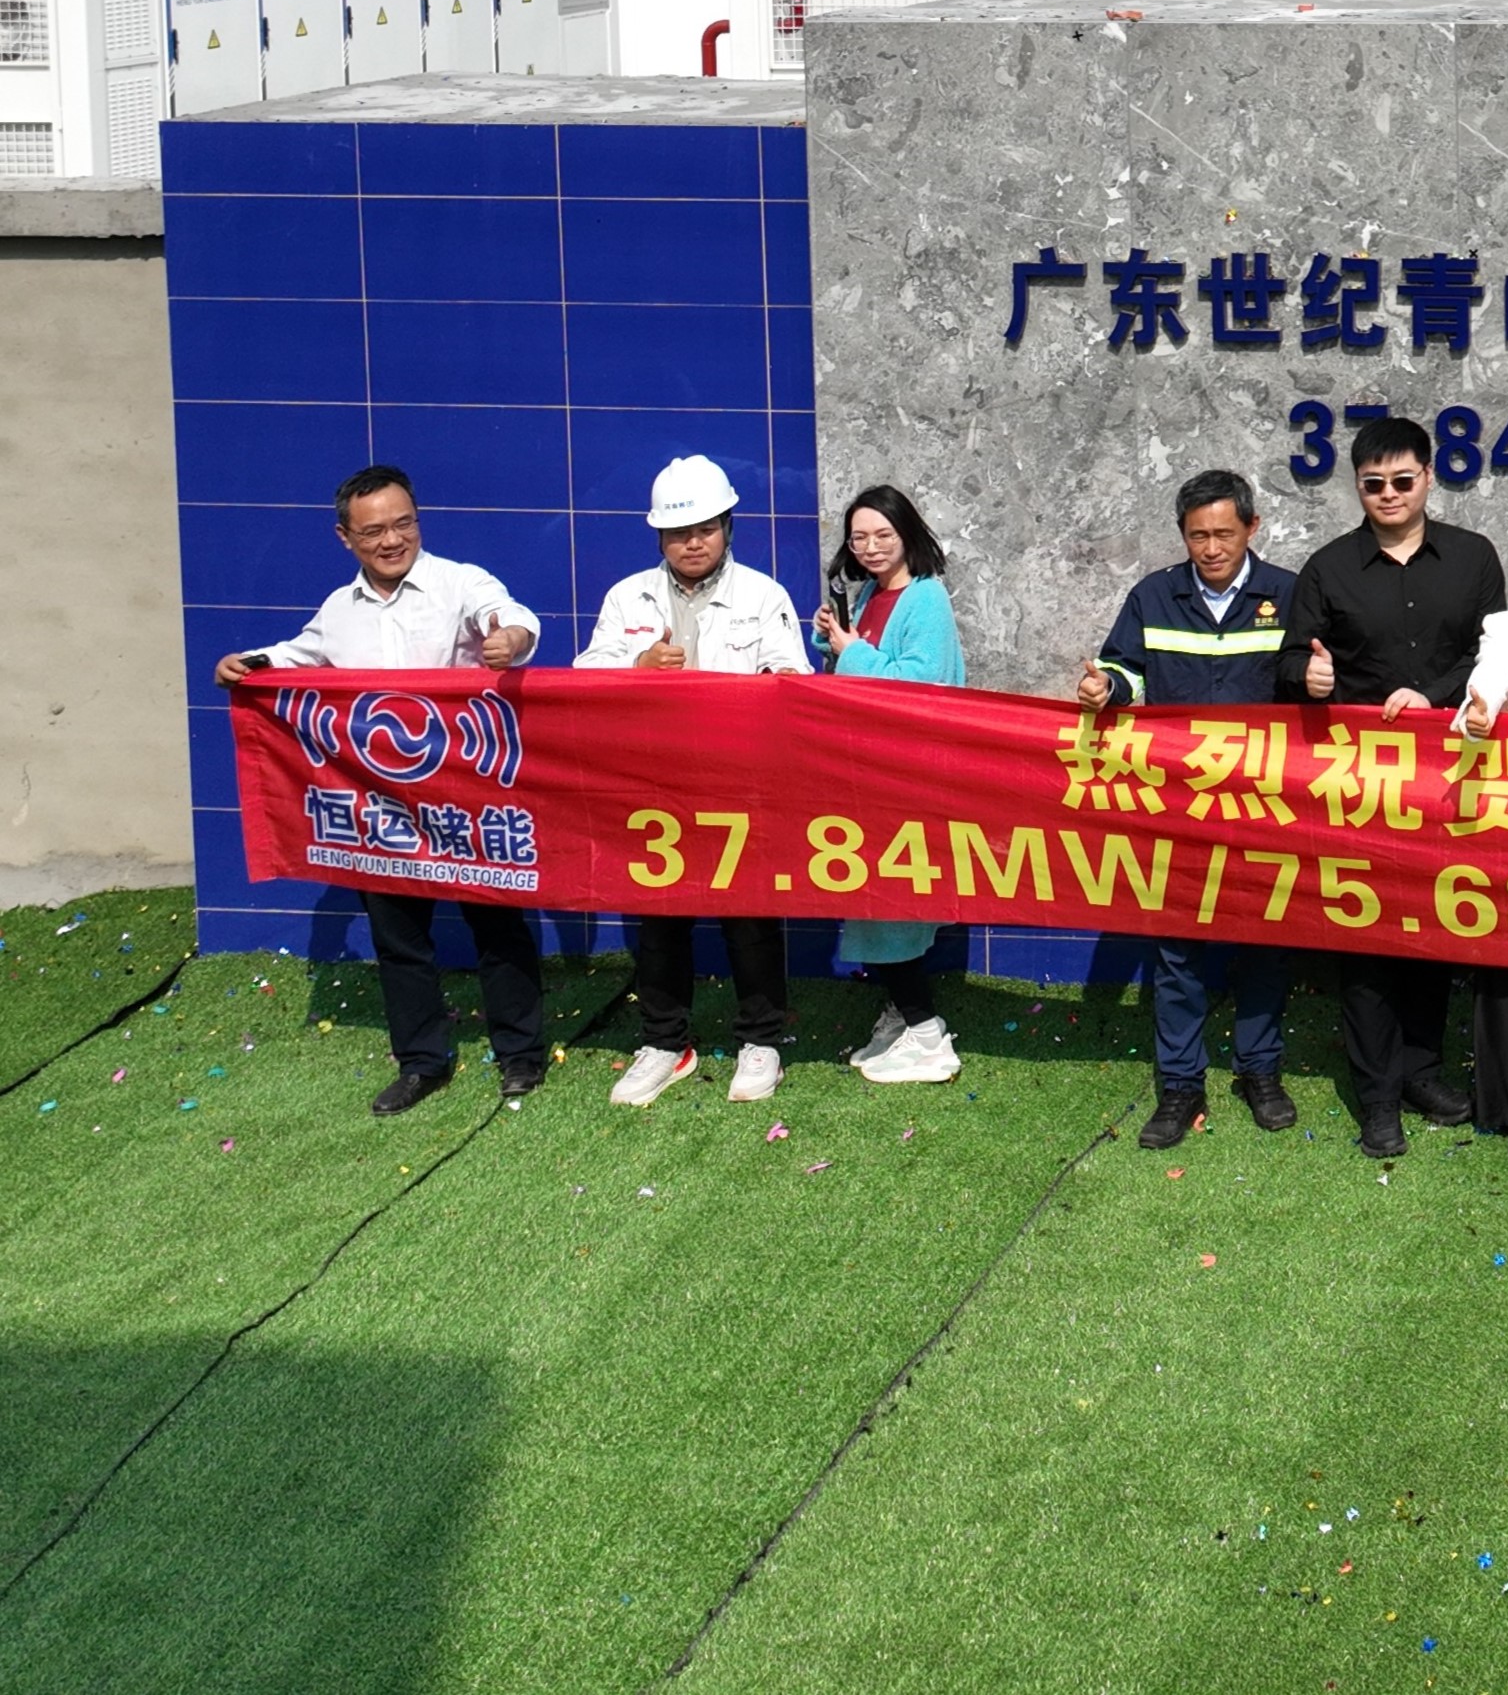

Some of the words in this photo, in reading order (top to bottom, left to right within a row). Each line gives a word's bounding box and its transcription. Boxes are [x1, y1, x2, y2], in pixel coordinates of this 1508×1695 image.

[306, 786, 537, 863] 恒运储能
[308, 846, 352, 869] HENG
[353, 854, 389, 875] YUN
[391, 858, 459, 883] ENERGY
[460, 865, 538, 890] STORAGE
